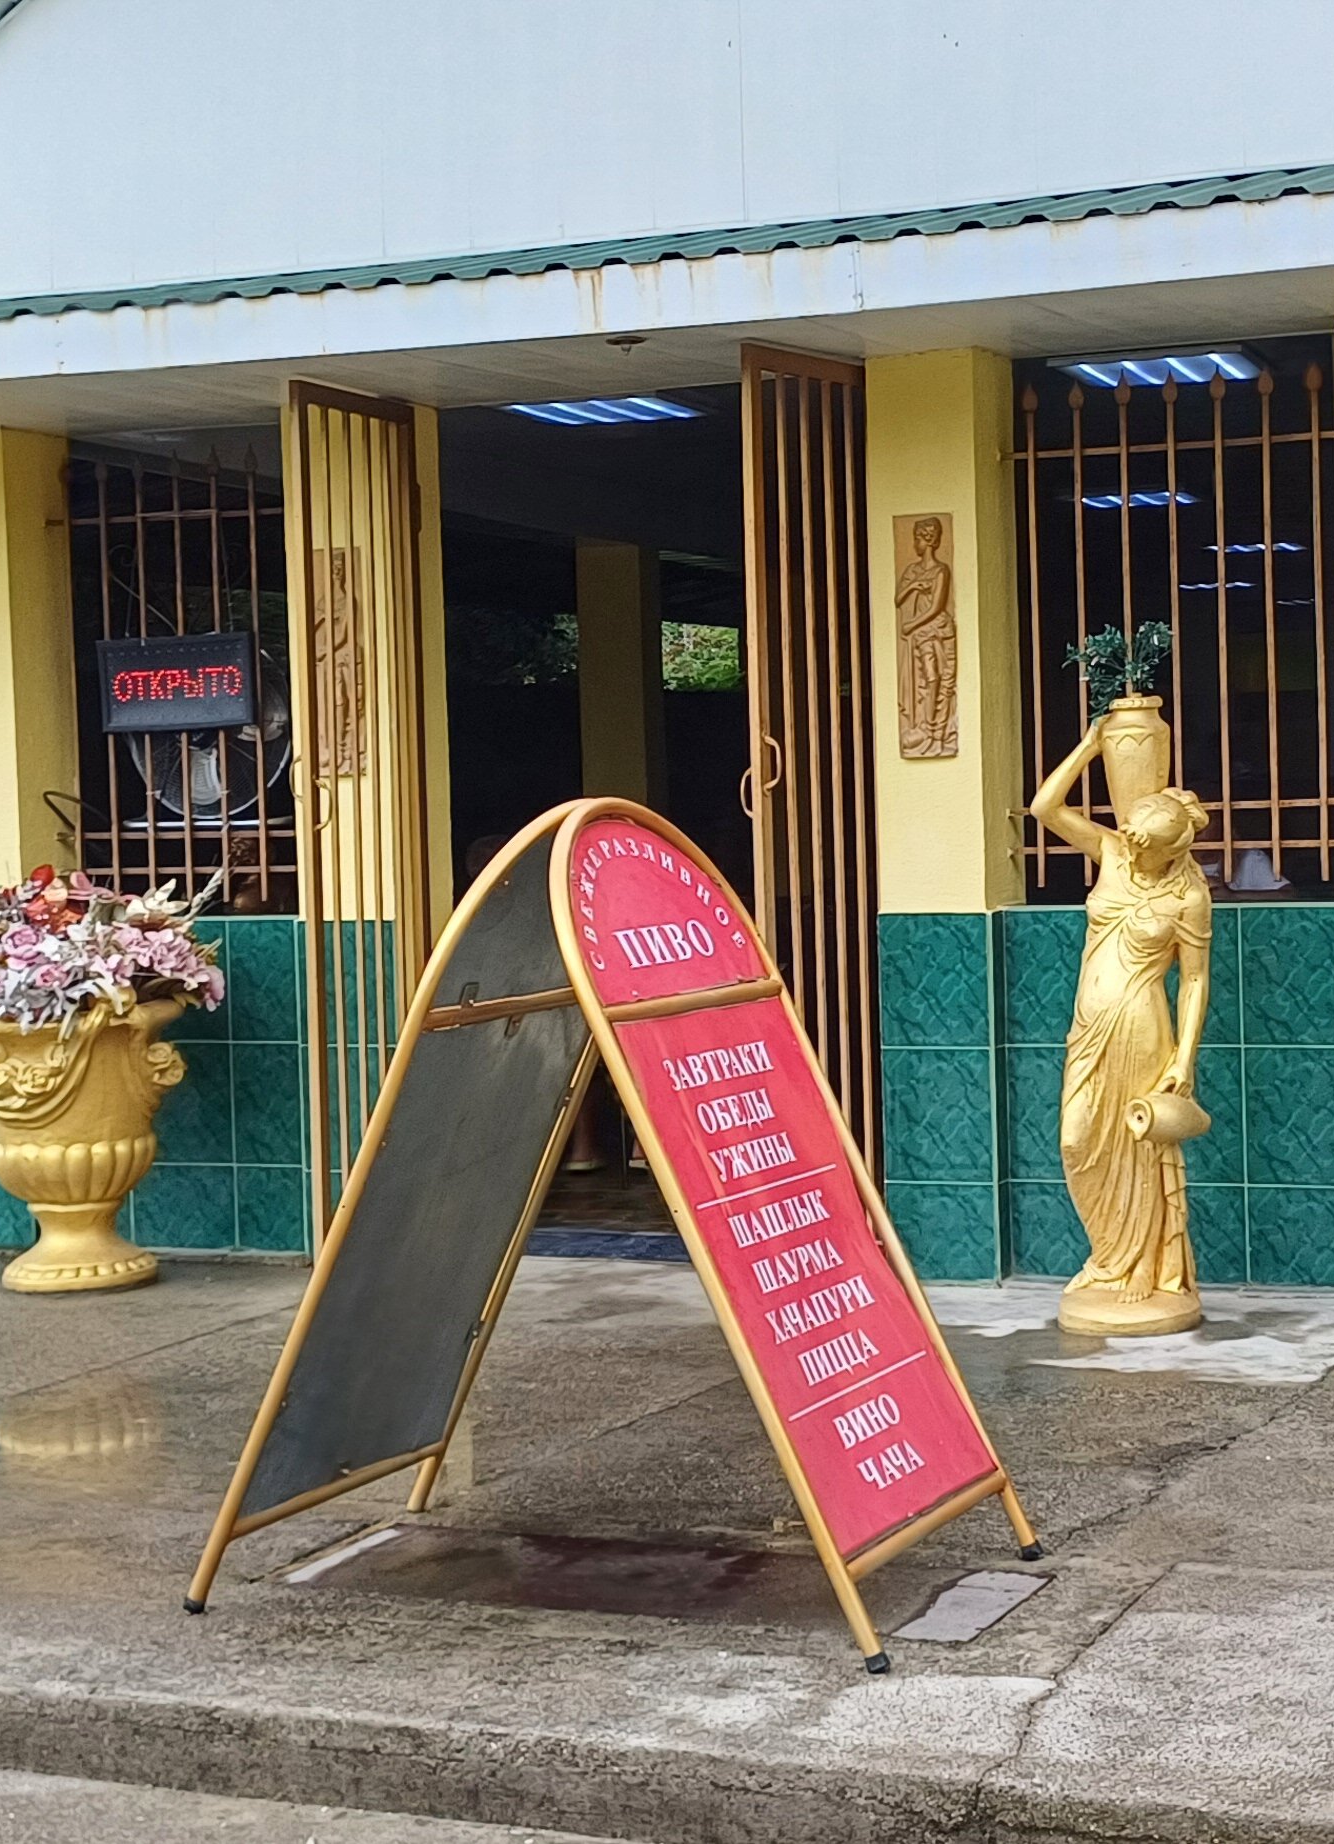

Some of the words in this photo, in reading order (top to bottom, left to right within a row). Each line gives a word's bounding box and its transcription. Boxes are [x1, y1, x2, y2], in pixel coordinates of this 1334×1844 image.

[113, 665, 243, 702] ОТКРЫТО
[579, 847, 605, 970] СВЕЖЕЕ
[598, 837, 746, 948] РАЗЛИВНОЕ
[612, 919, 714, 968] ПИВО
[662, 1040, 774, 1092] ЗАВТРАКИ
[696, 1088, 775, 1132] ОБЕДЫ
[708, 1131, 797, 1183] УЖИНЫ
[727, 1188, 831, 1249] ШАШЛЫК
[751, 1236, 844, 1294] ШАУРМА
[764, 1274, 876, 1346] ХАЧАПУРИ
[797, 1327, 880, 1387] ПИЦЦА
[832, 1393, 901, 1450] ВИНО
[856, 1439, 926, 1491] ЧАЧА
